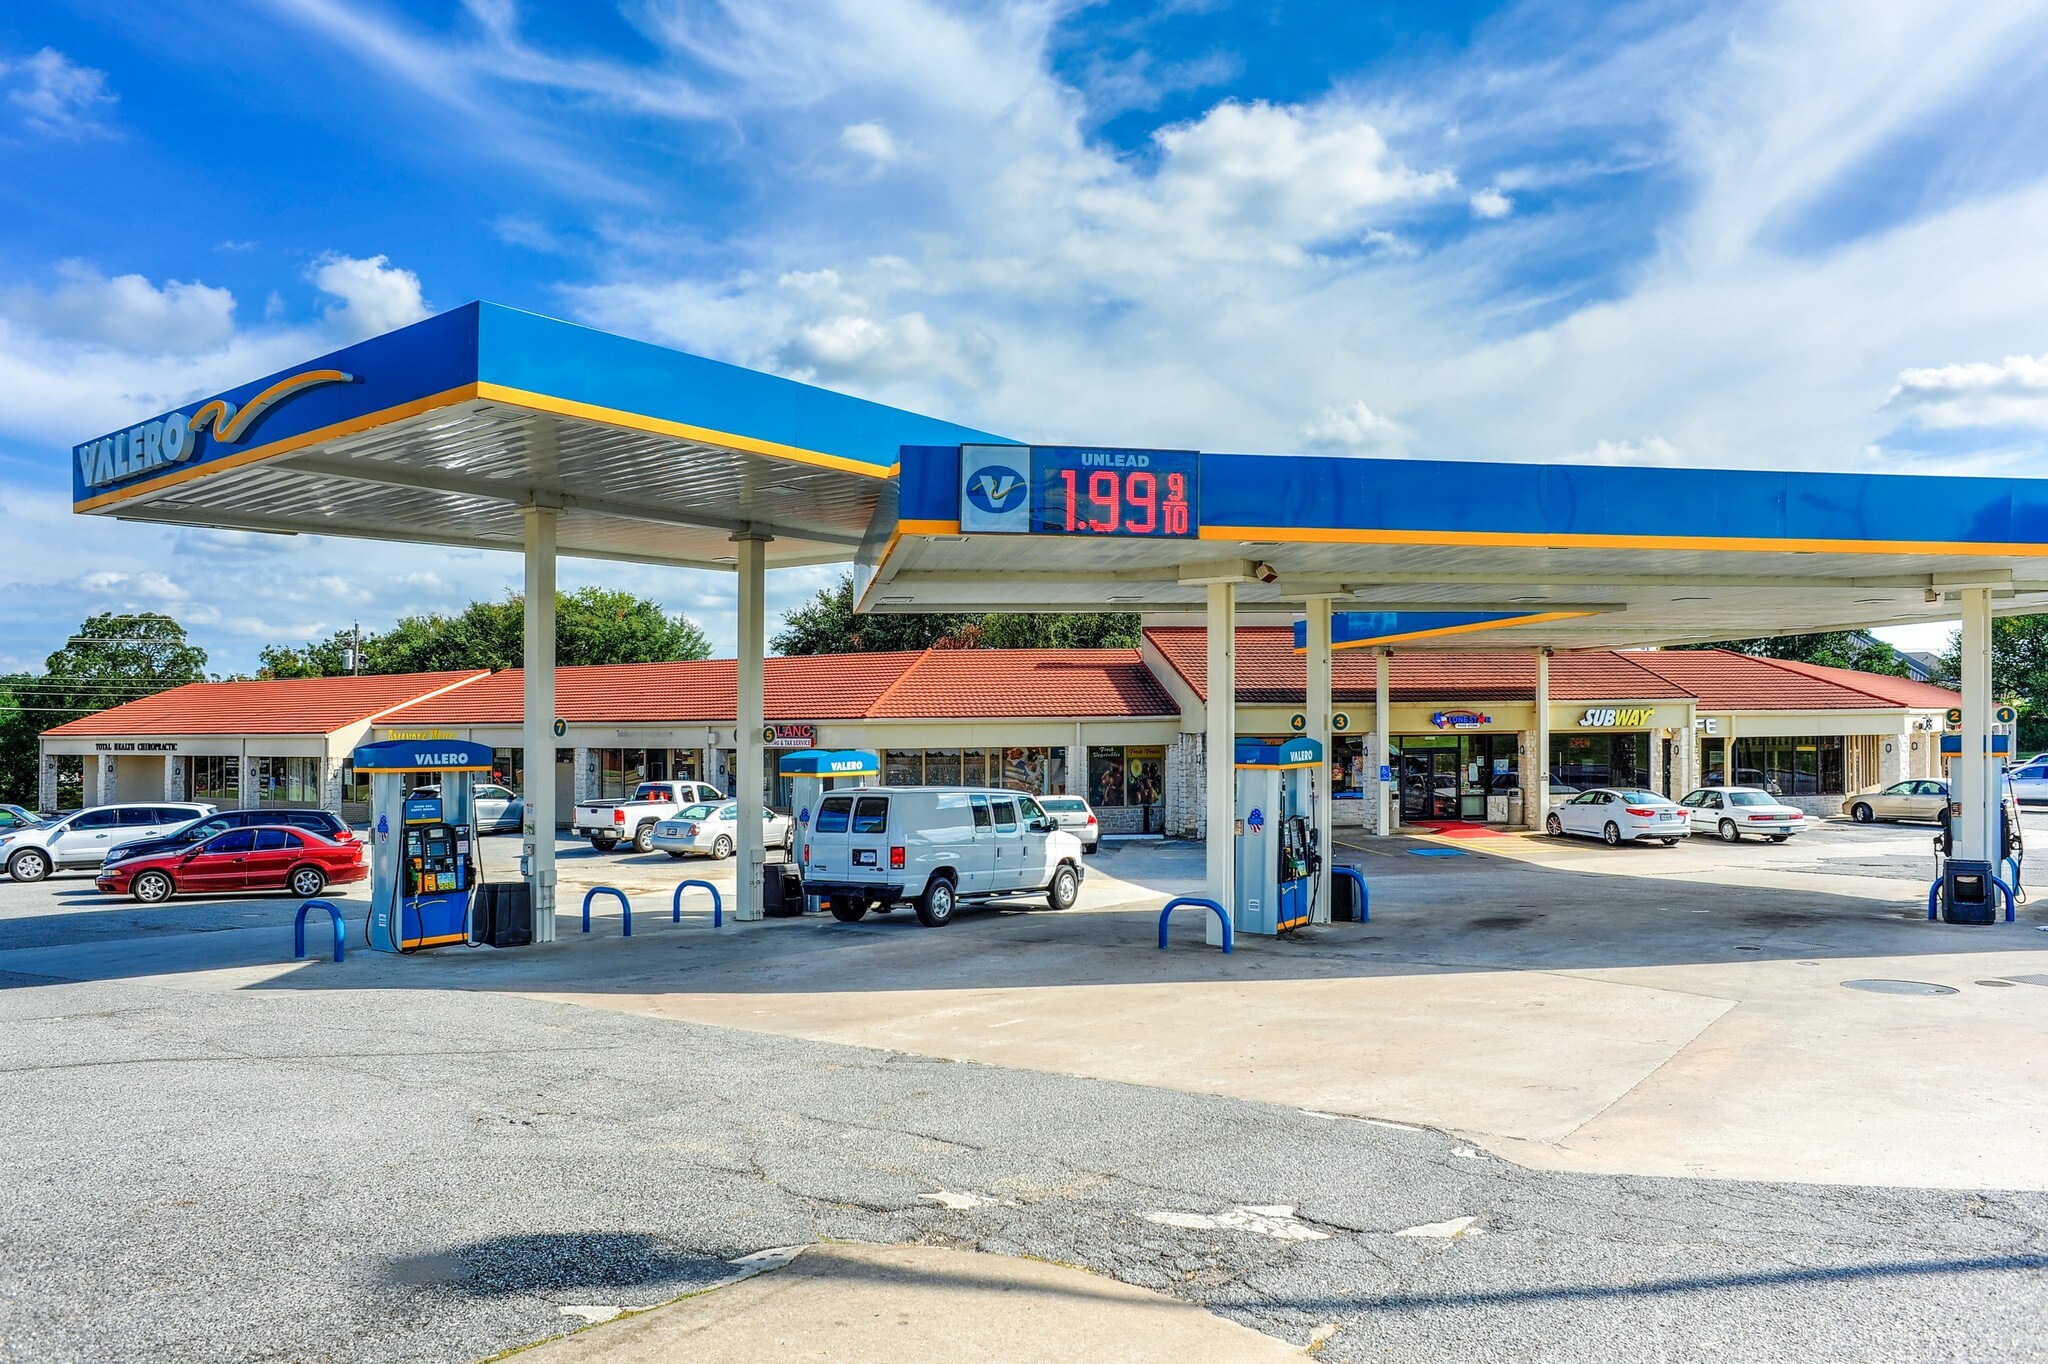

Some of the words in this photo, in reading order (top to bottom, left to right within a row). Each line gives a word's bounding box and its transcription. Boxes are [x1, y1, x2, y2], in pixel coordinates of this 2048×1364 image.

[79, 413, 190, 487] VALERO
[1081, 453, 1149, 468] UNLEAD
[1168, 472, 1184, 501] 9
[1061, 469, 1156, 533] 1.99
[1162, 505, 1188, 534] 10
[1578, 708, 1656, 727] SUBWAY
[1950, 710, 1960, 720] 2
[2001, 710, 2009, 720] 1
[556, 722, 563, 734] 7
[1294, 717, 1303, 728] 4
[1336, 716, 1345, 728] 3
[766, 730, 773, 740] 5
[95, 742, 113, 751] TOTAL
[113, 742, 135, 751] HEALTH
[137, 742, 178, 751] CHIROPRACTIC
[415, 753, 469, 765] VALERO
[1289, 750, 1313, 762] VALERO
[831, 761, 863, 772] VALERO
